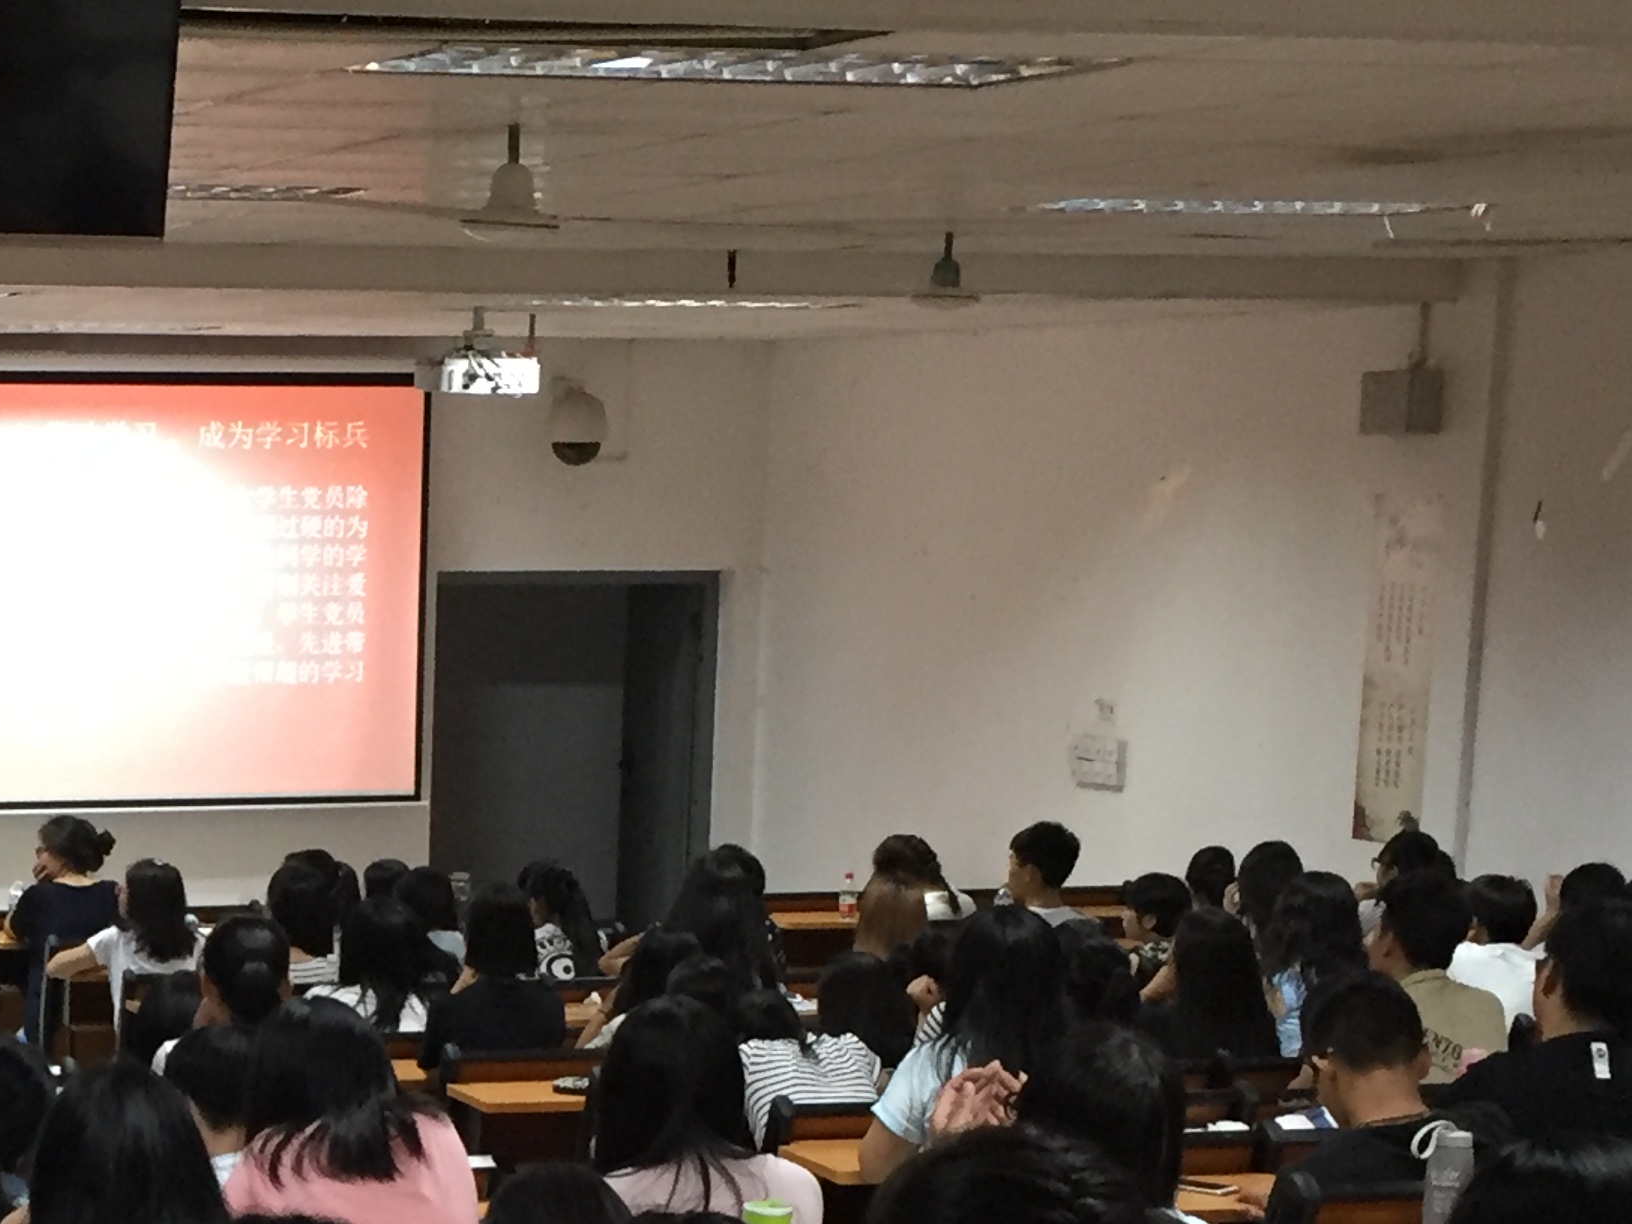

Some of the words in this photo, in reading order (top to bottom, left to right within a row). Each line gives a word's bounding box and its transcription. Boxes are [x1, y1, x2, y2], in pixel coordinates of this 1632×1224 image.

[198, 420, 369, 450] 成为学习标兵
